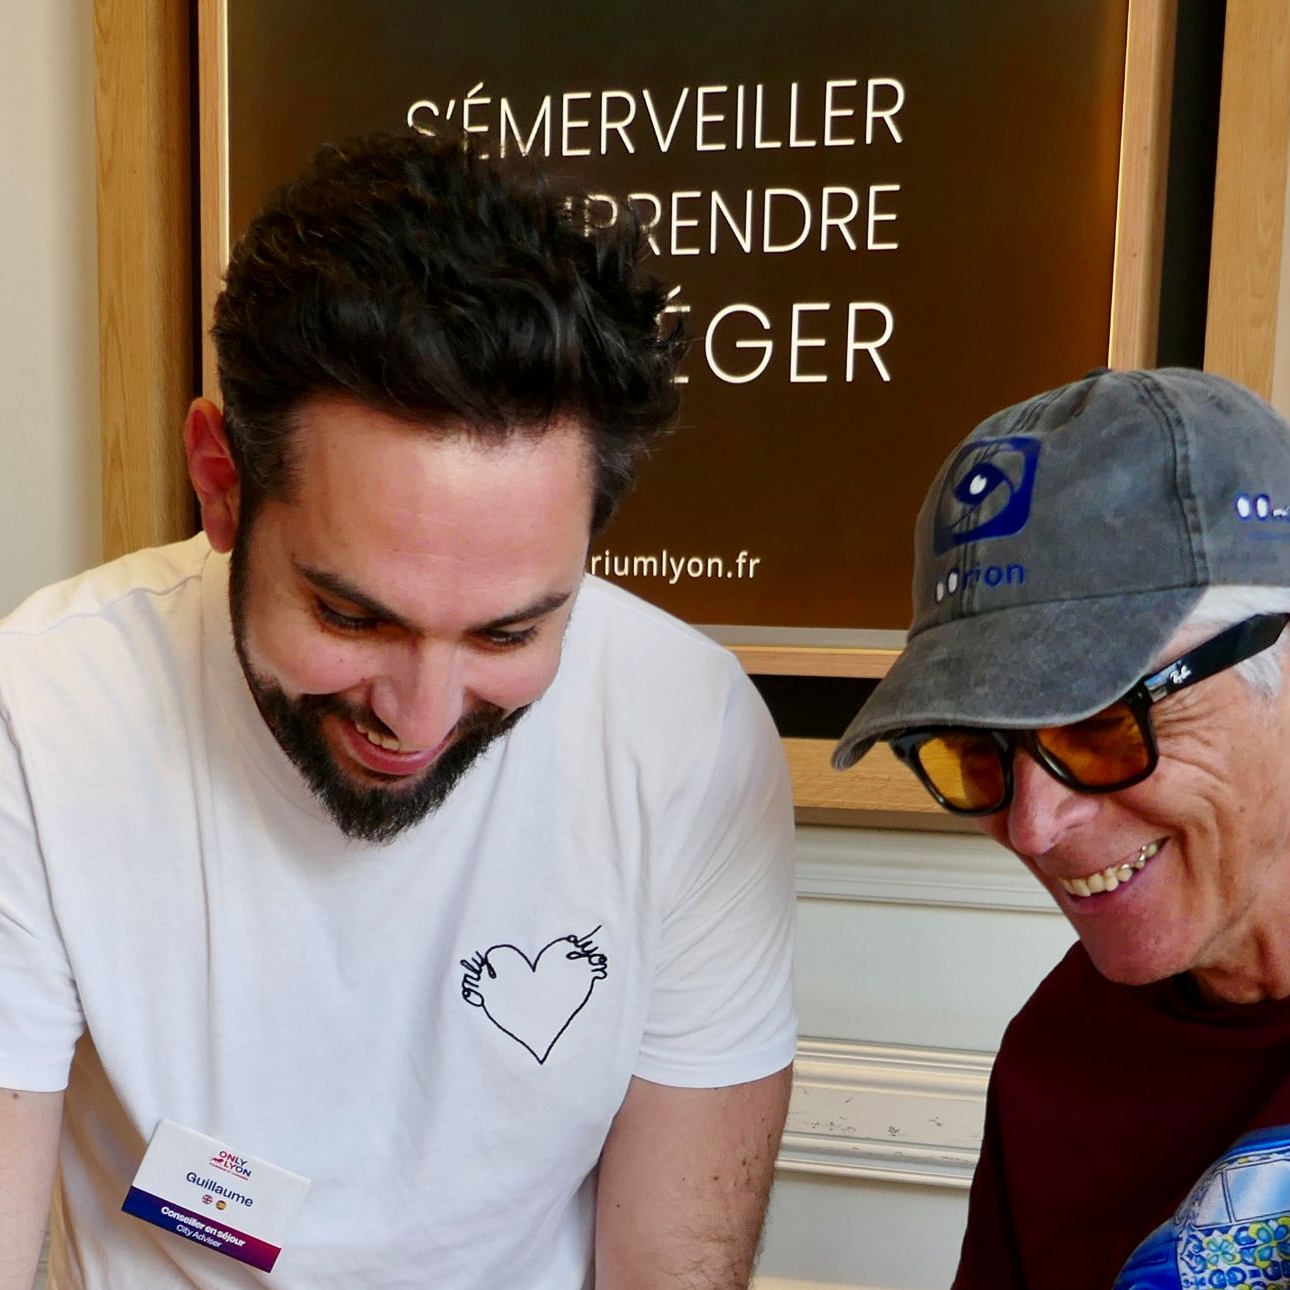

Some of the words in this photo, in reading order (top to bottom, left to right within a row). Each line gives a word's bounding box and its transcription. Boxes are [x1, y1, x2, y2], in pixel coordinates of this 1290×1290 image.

[563, 184, 901, 256] PRENDRE
[657, 285, 894, 384] ÉGER
[590, 549, 762, 585] riumlyon.fr
[460, 951, 497, 1007] only
[219, 1150, 248, 1167] ONLY
[224, 1160, 252, 1178] LYON
[185, 1171, 254, 1208] Guillaume
[160, 1206, 206, 1231] Conseiller
[204, 1224, 218, 1235] en
[217, 1229, 246, 1248] séjour
[176, 1224, 194, 1237] City
[192, 1230, 222, 1249] Adviser
